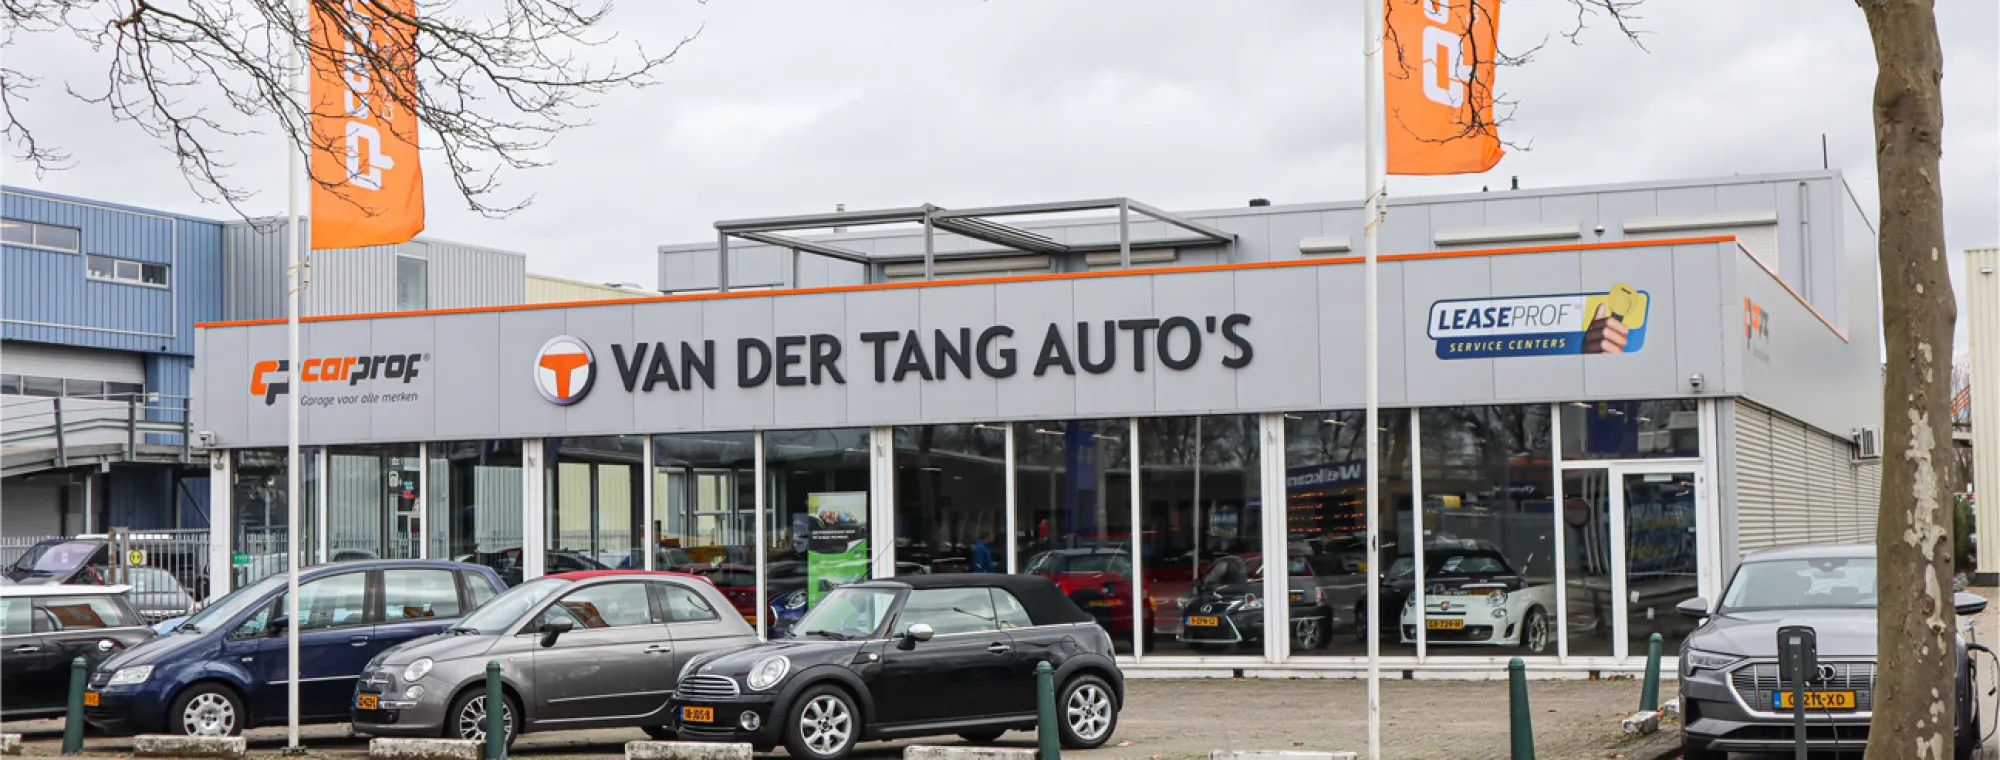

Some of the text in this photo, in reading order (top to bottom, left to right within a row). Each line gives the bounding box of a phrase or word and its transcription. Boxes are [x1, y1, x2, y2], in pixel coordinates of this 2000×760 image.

[1438, 303, 1572, 330] LEASEPROF
[610, 313, 1254, 393] VAN DER TANG AUTO'S
[1449, 338, 1567, 353] SERVICE CENTERS
[300, 391, 419, 408] Garage voor alle merken
